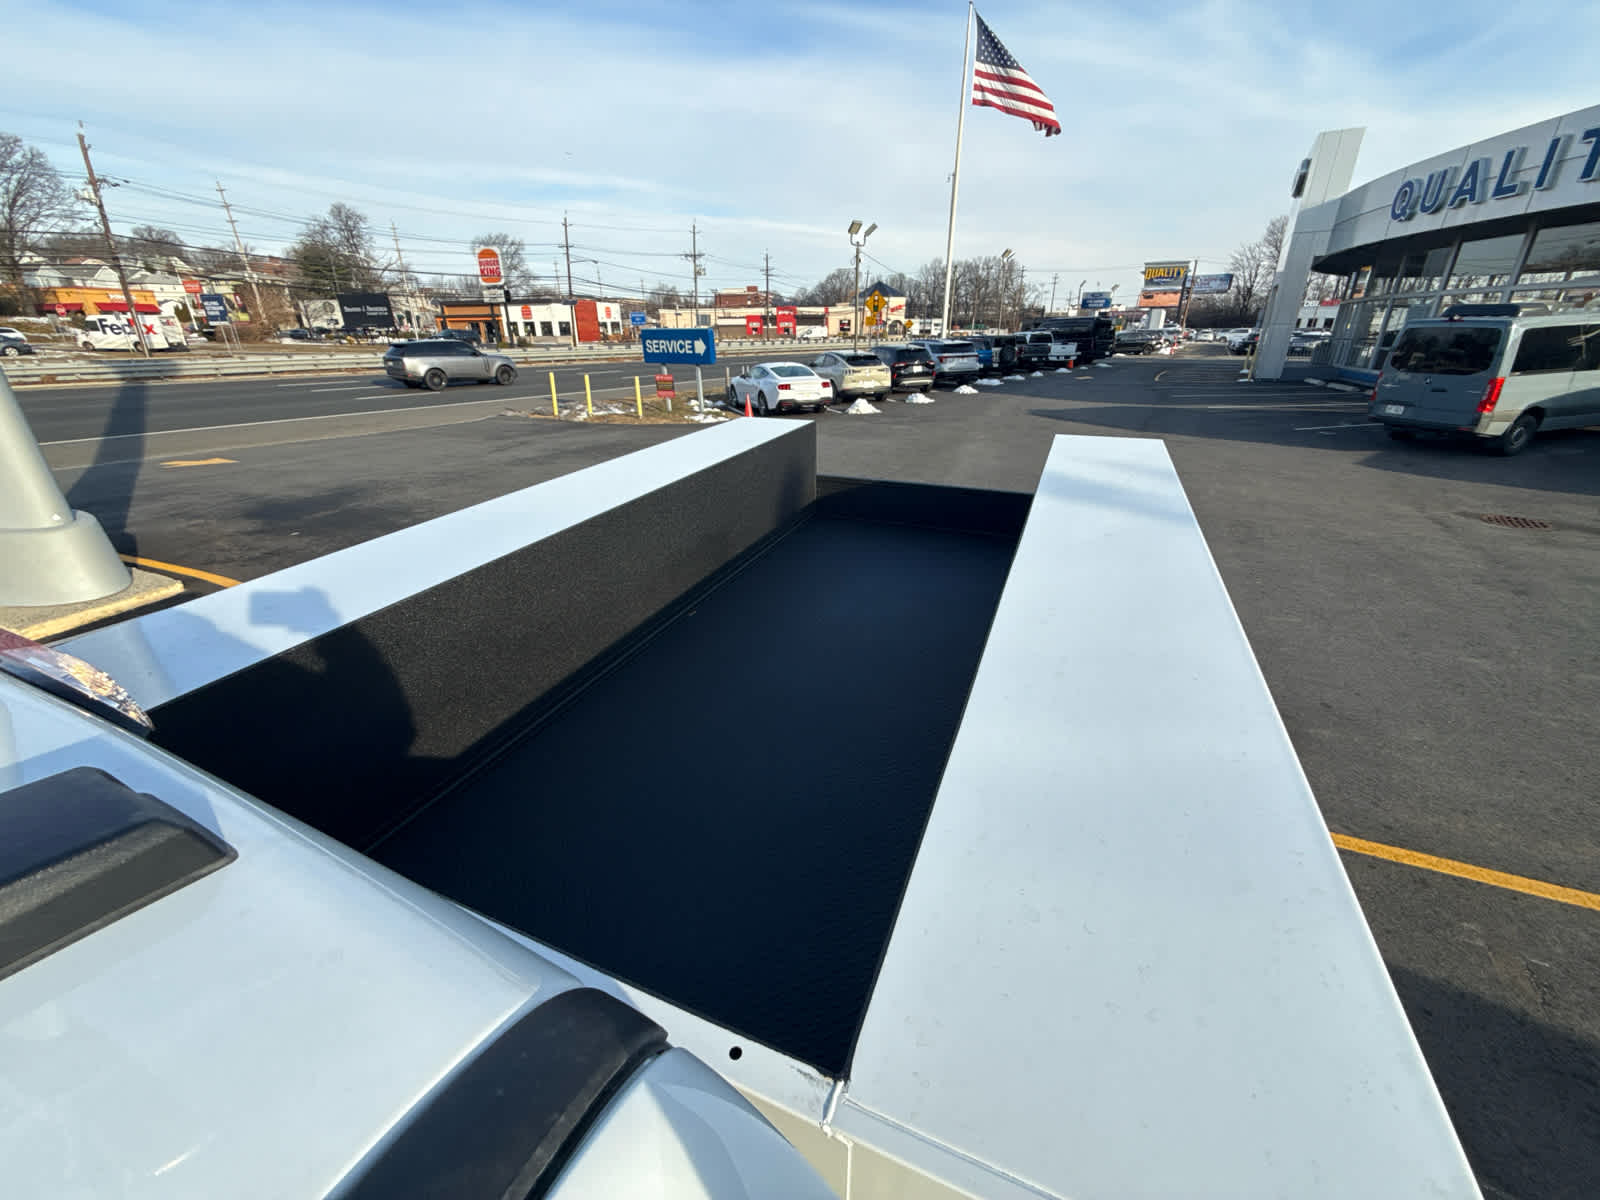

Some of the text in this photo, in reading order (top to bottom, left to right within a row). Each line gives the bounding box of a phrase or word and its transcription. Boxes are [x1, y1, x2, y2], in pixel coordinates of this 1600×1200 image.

[480, 267, 502, 277] KING
[1144, 266, 1187, 280] QUALITY
[98, 318, 157, 335] Fedx
[645, 339, 693, 354] SERVICE
